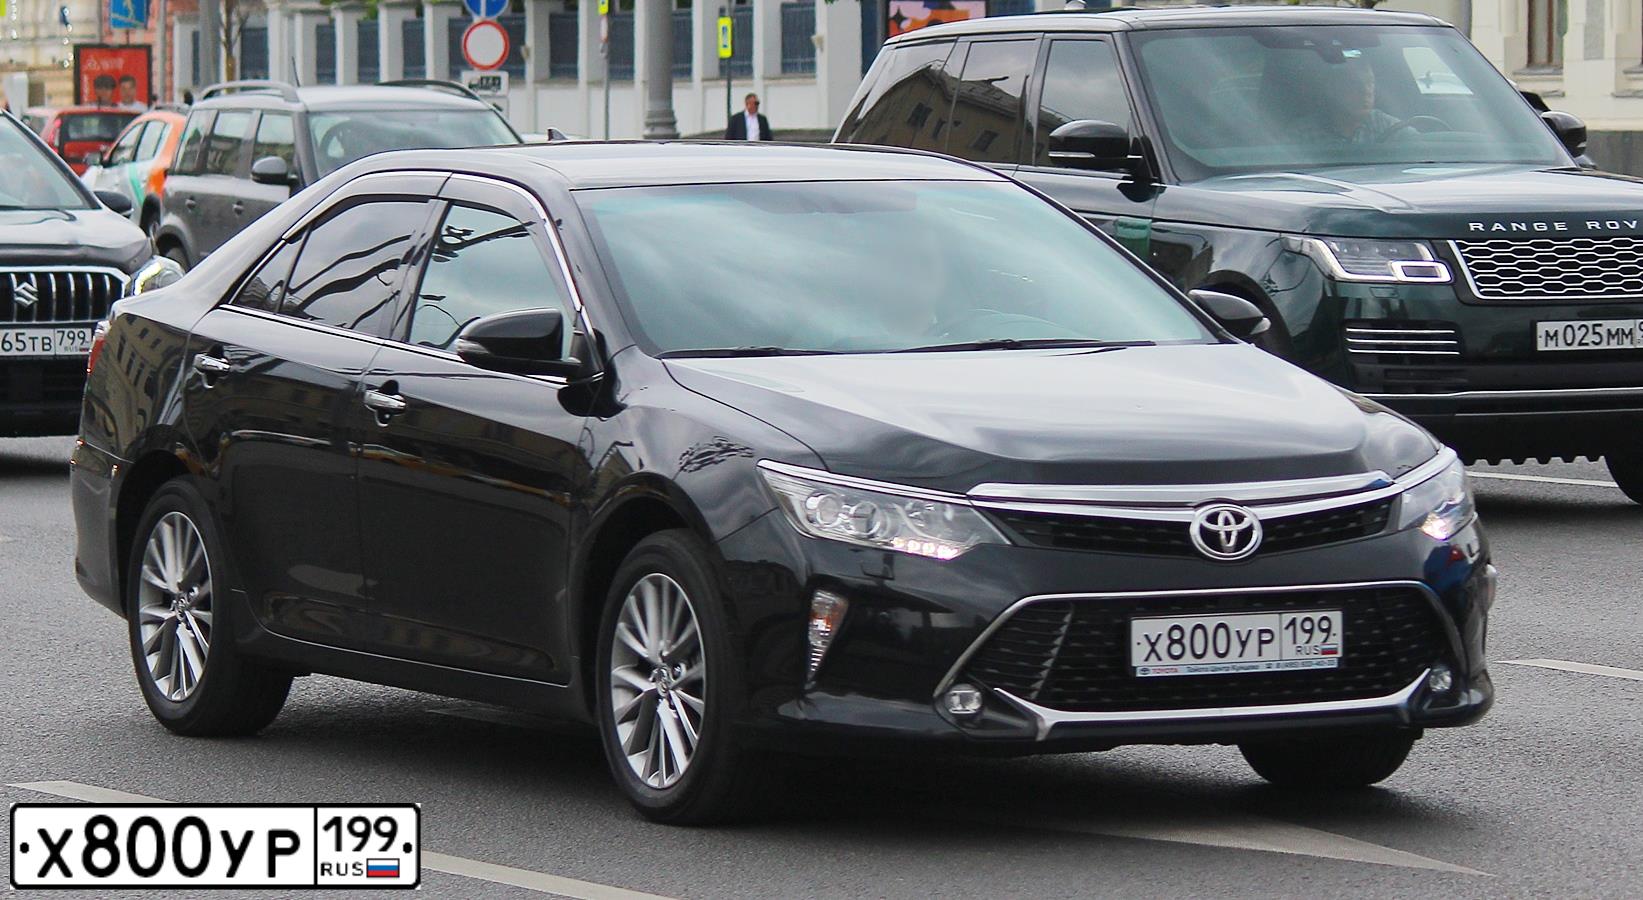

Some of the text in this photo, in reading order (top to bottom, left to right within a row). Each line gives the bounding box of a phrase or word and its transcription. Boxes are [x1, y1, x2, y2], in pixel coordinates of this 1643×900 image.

[1468, 220, 1638, 231] RANGE ROV
[56, 330, 87, 346] 799
[1544, 323, 1634, 347] М025ММ
[1284, 615, 1332, 645] 199
[1296, 645, 1320, 656] RUS
